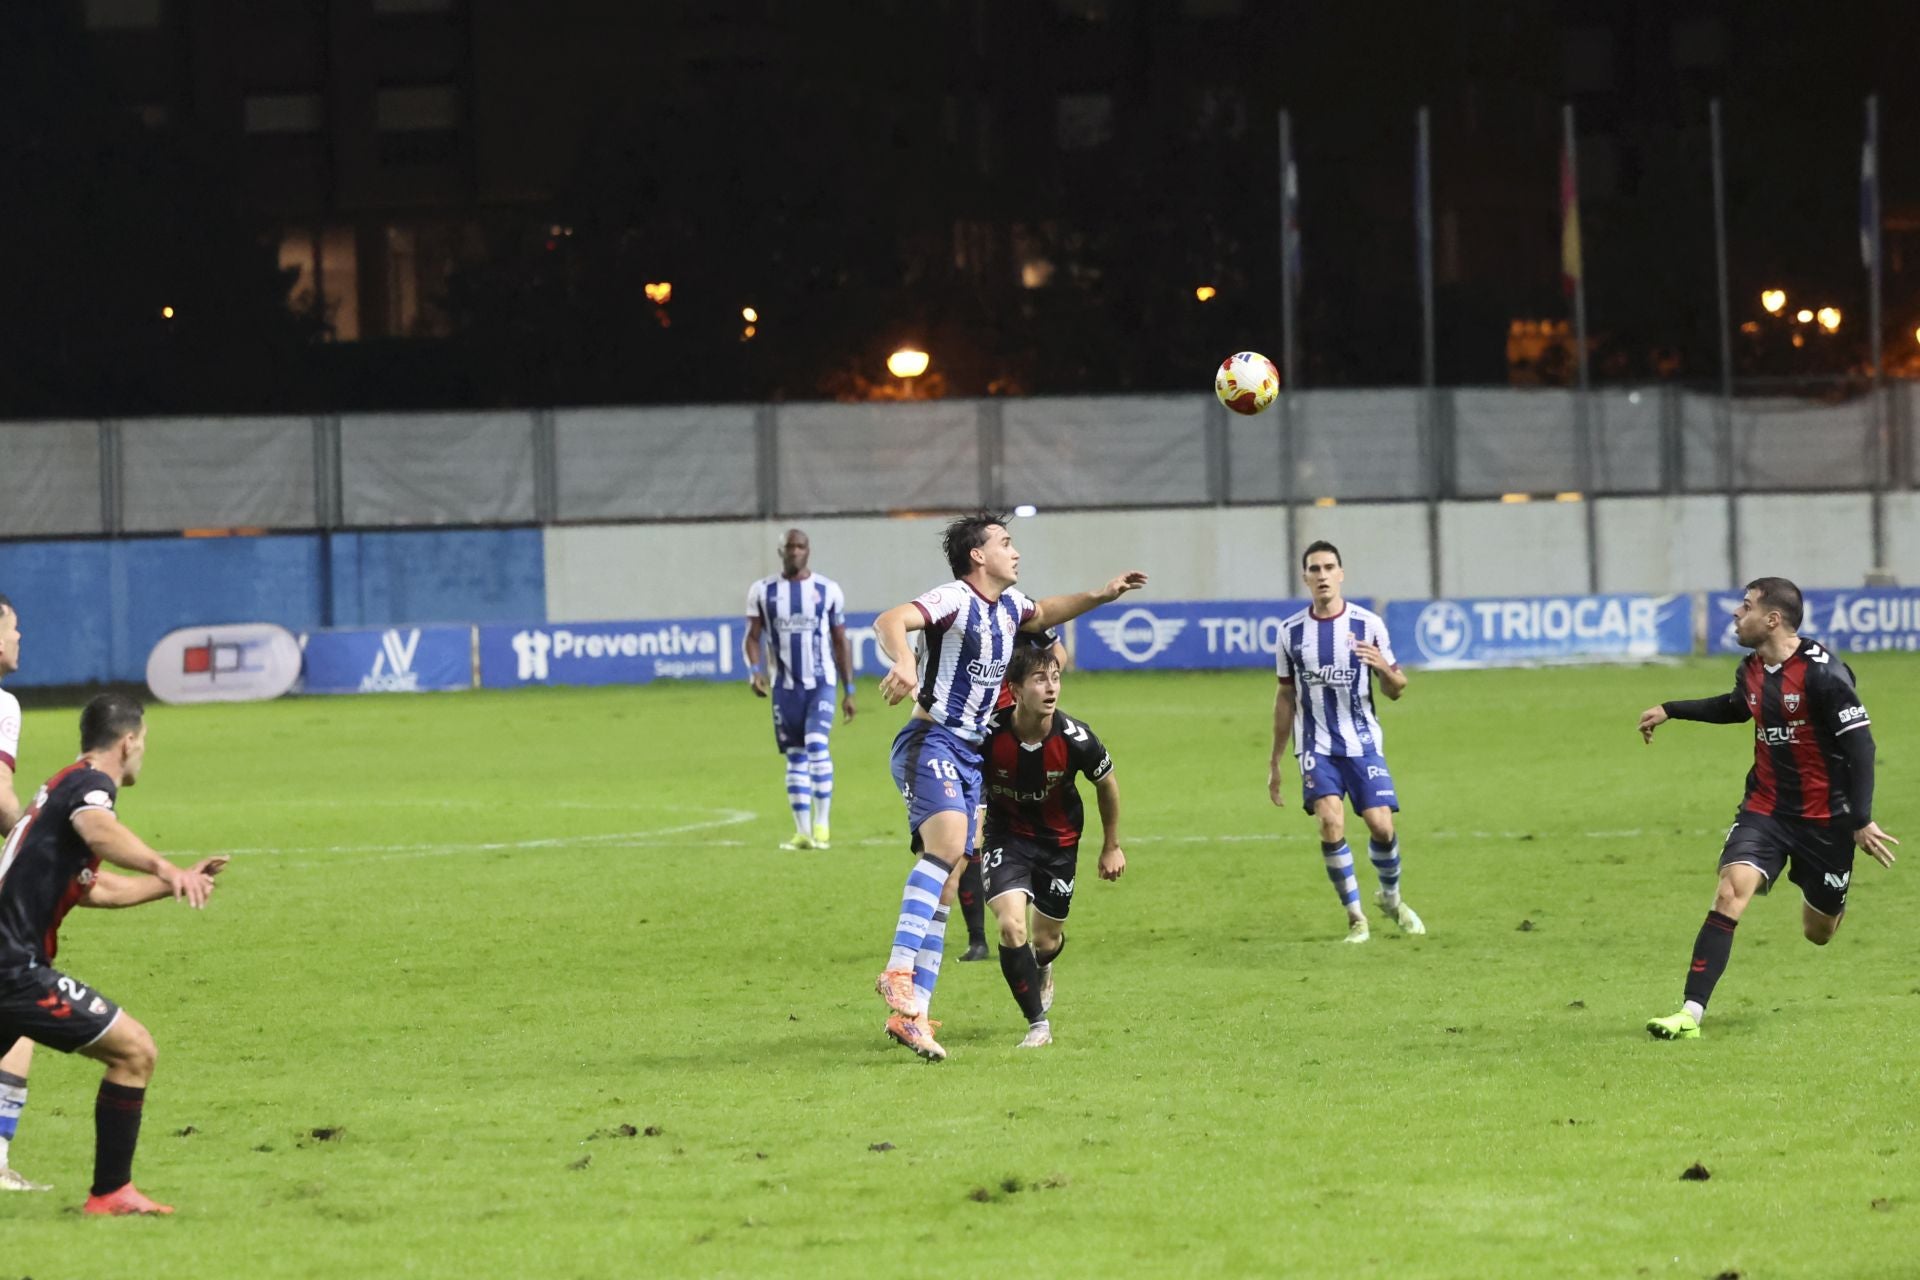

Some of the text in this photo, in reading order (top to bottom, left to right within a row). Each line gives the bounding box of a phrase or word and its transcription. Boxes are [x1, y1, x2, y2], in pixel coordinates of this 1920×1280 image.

[1473, 599, 1658, 640] TRIOCAR
[553, 624, 717, 658] Preventiva
[927, 758, 959, 780] 18
[982, 848, 1004, 873] 23
